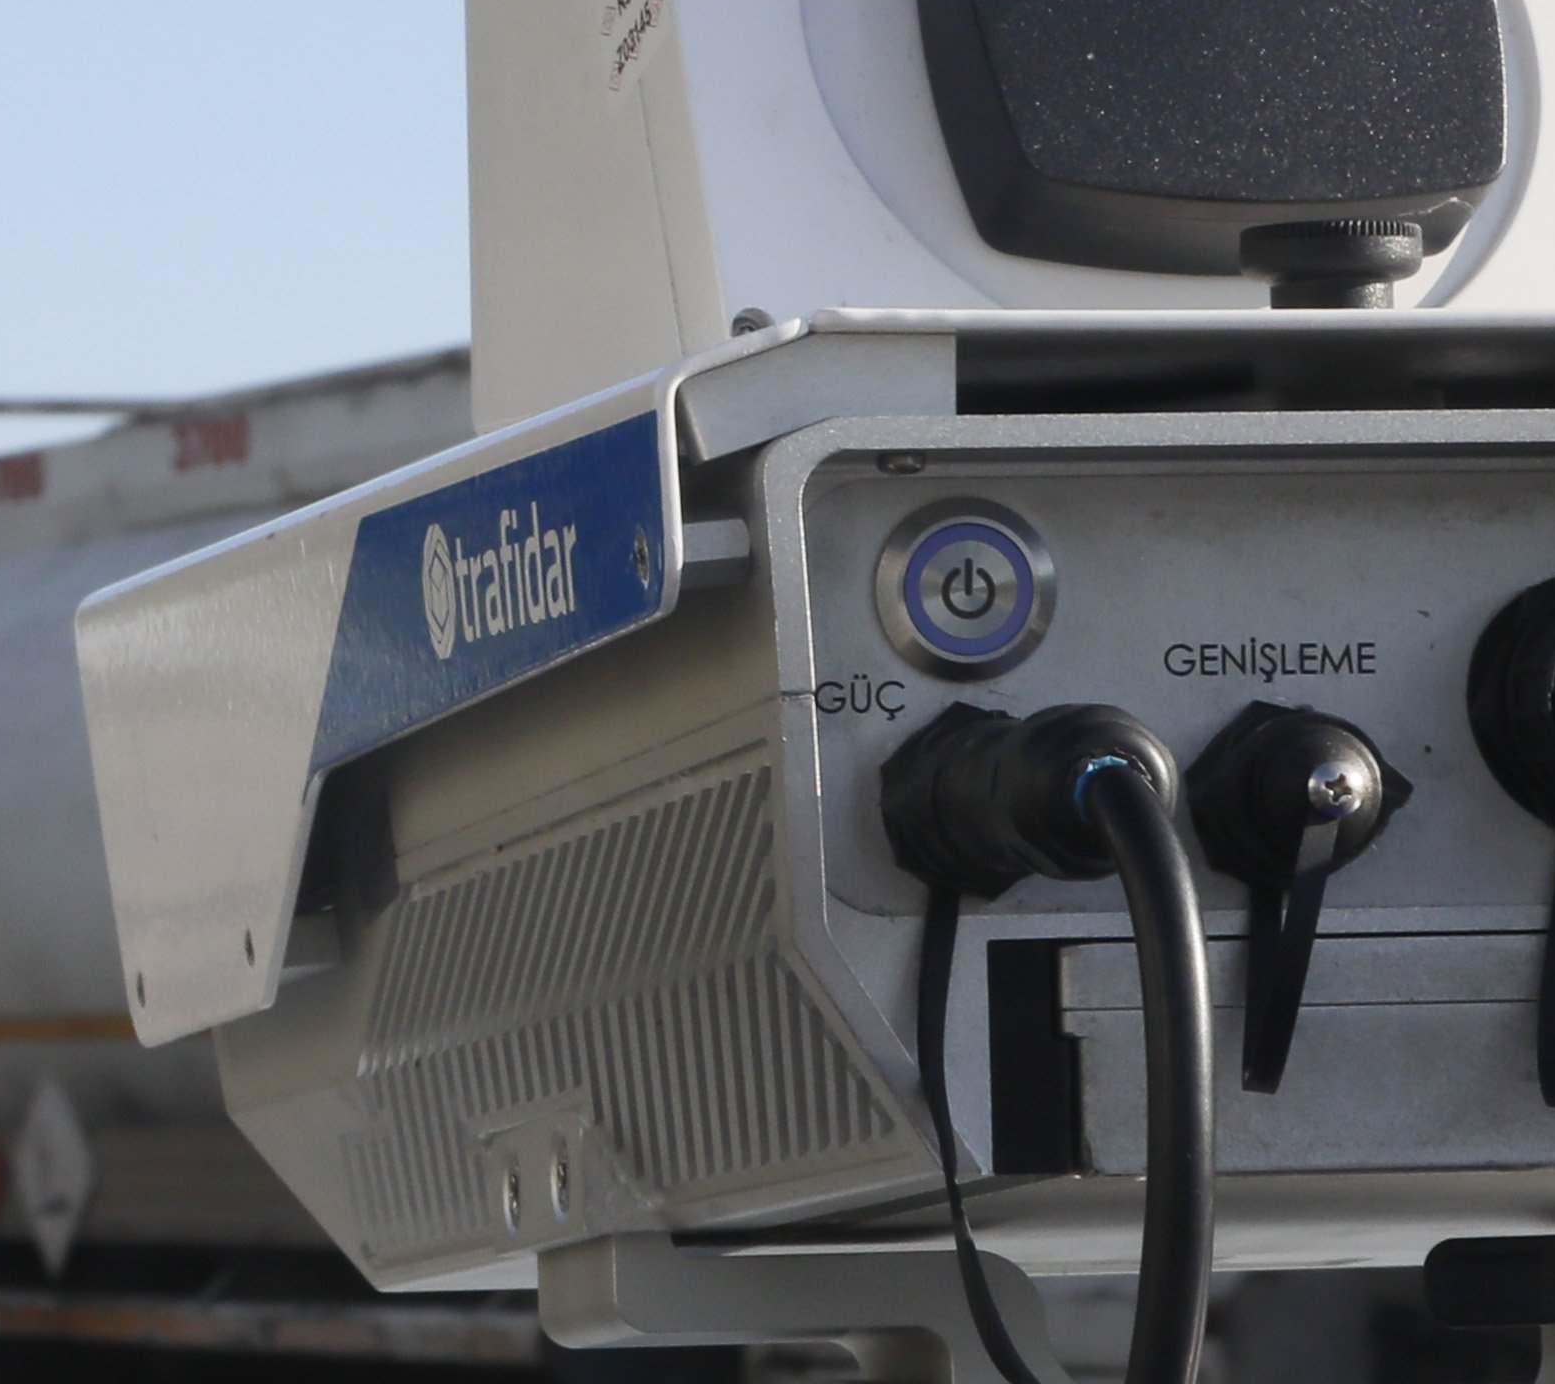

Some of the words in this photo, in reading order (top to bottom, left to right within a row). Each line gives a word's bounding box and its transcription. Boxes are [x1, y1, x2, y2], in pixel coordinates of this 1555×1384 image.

[455, 501, 577, 643] trafidar
[1163, 636, 1377, 683] GENİŞLEME
[815, 674, 906, 721] GÜÇ
